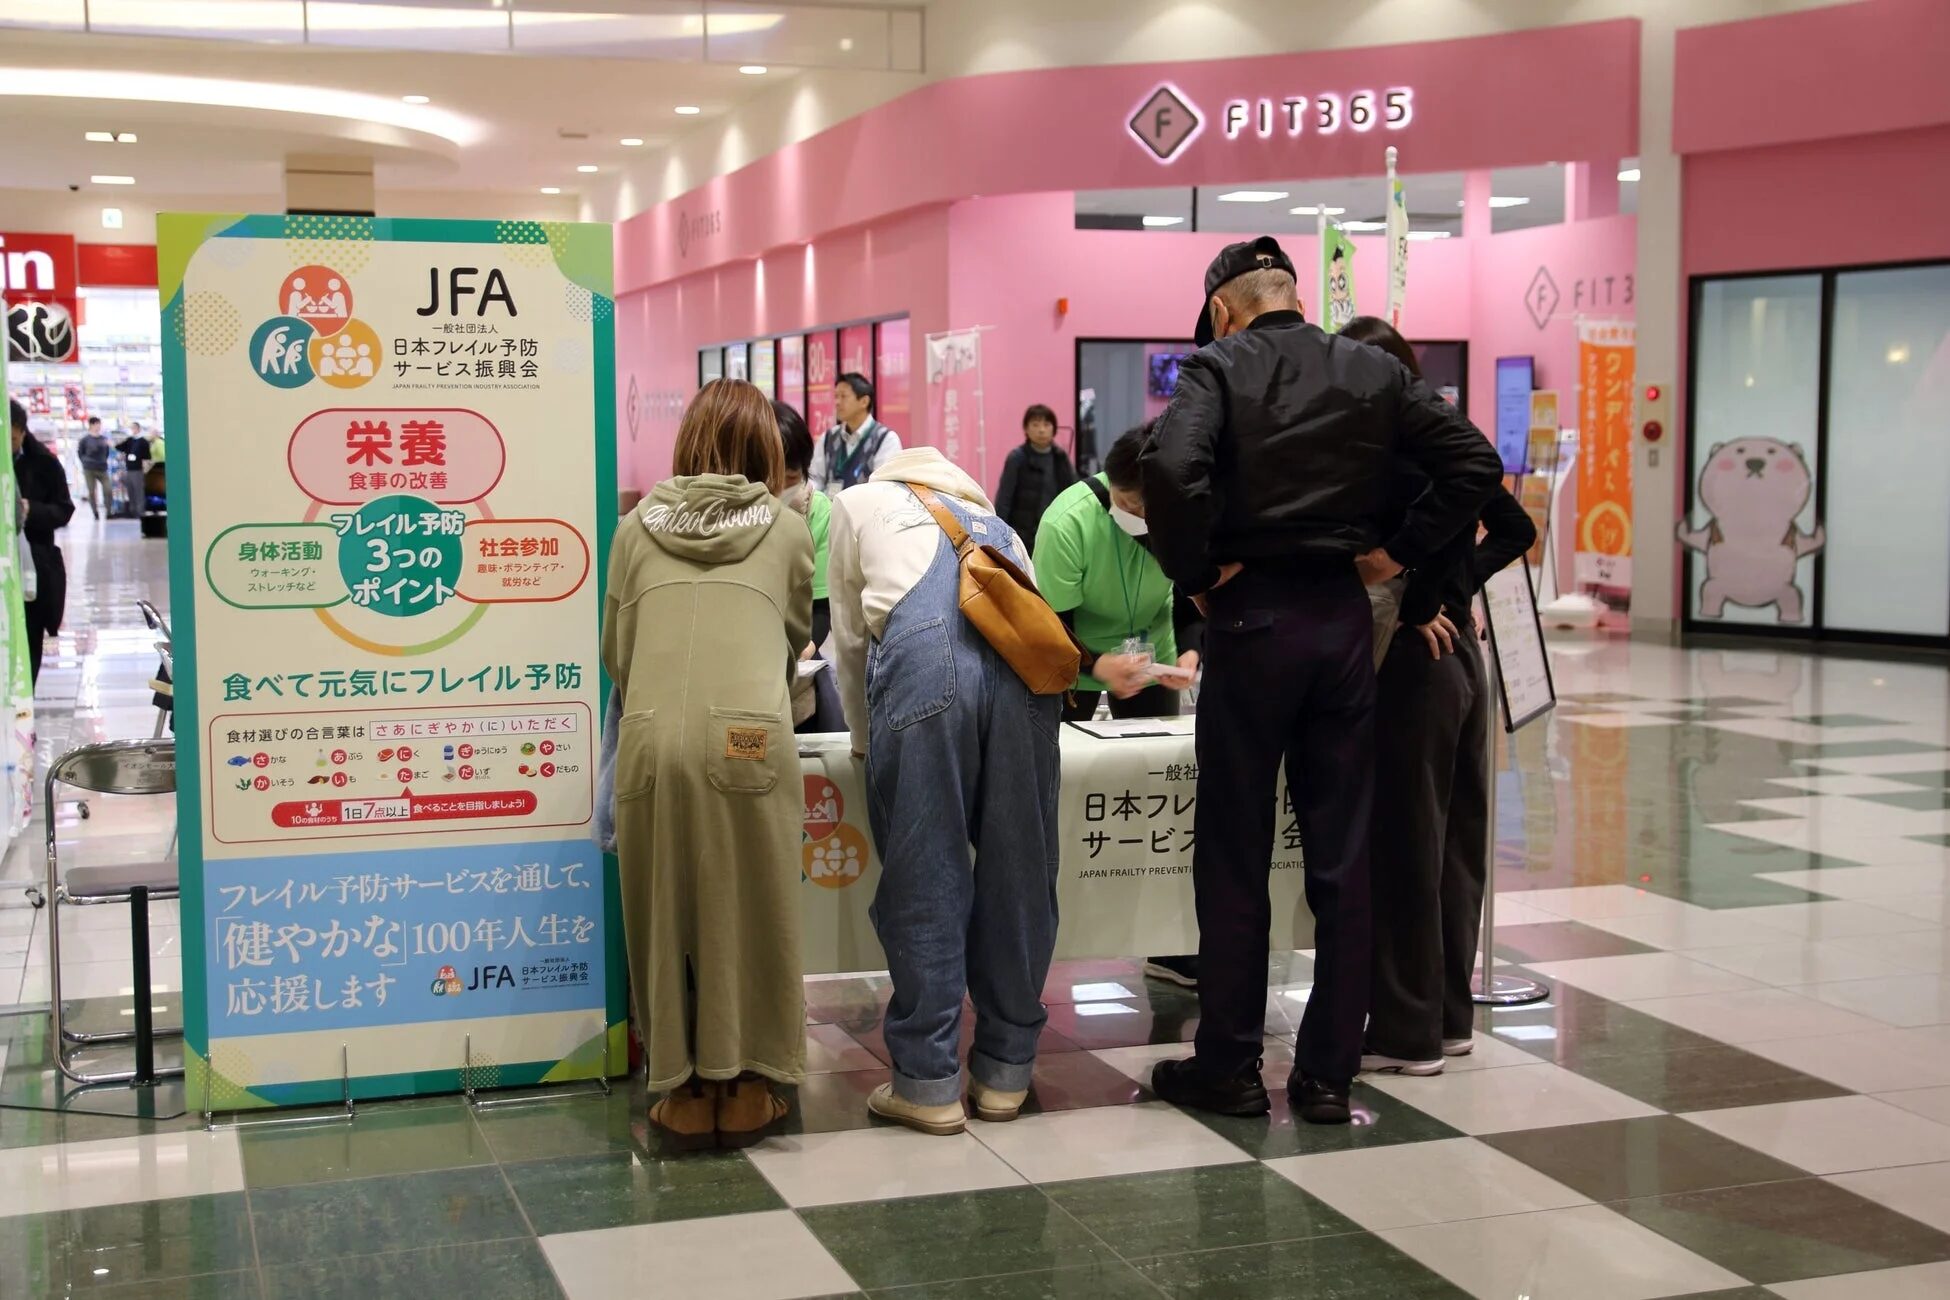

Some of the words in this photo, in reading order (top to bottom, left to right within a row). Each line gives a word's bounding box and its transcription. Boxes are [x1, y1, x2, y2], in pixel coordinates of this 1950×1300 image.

[1225, 89, 1410, 136] FIT365
[416, 267, 518, 317] JFA
[431, 323, 499, 334] 一般社団法人
[393, 337, 539, 358] 日本フレイル予防
[393, 359, 539, 379] サービス振興会
[345, 419, 448, 468] 栄養
[348, 471, 448, 491] 食事の改善
[332, 512, 466, 536] フレイル予防
[238, 540, 323, 563] 身体活動
[365, 538, 443, 573] 3つの
[479, 537, 560, 558] 社会参加
[247, 580, 317, 593] ストレッチなど
[351, 576, 456, 607] ポイント
[501, 576, 542, 588] 就労など
[222, 662, 583, 702] 食べて元気にフレイル予防
[226, 725, 366, 744] 食材選びの合言葉は
[1148, 763, 1200, 781] 一般社
[344, 801, 408, 820] 1日7点以上
[1085, 789, 1195, 822] 日本フレ
[1078, 869, 1108, 879] JAPAN
[1109, 867, 1147, 878] FRAILTY
[1148, 864, 1192, 876] PREVENTI
[217, 862, 592, 913] フレイル予防サービスを通して、
[215, 912, 597, 971] 「健やかな」100年人生を
[467, 964, 516, 991] JFA
[521, 961, 589, 976] 日本フレイル予防
[521, 972, 590, 985] サービス振興会
[225, 972, 397, 1018] 応援します
